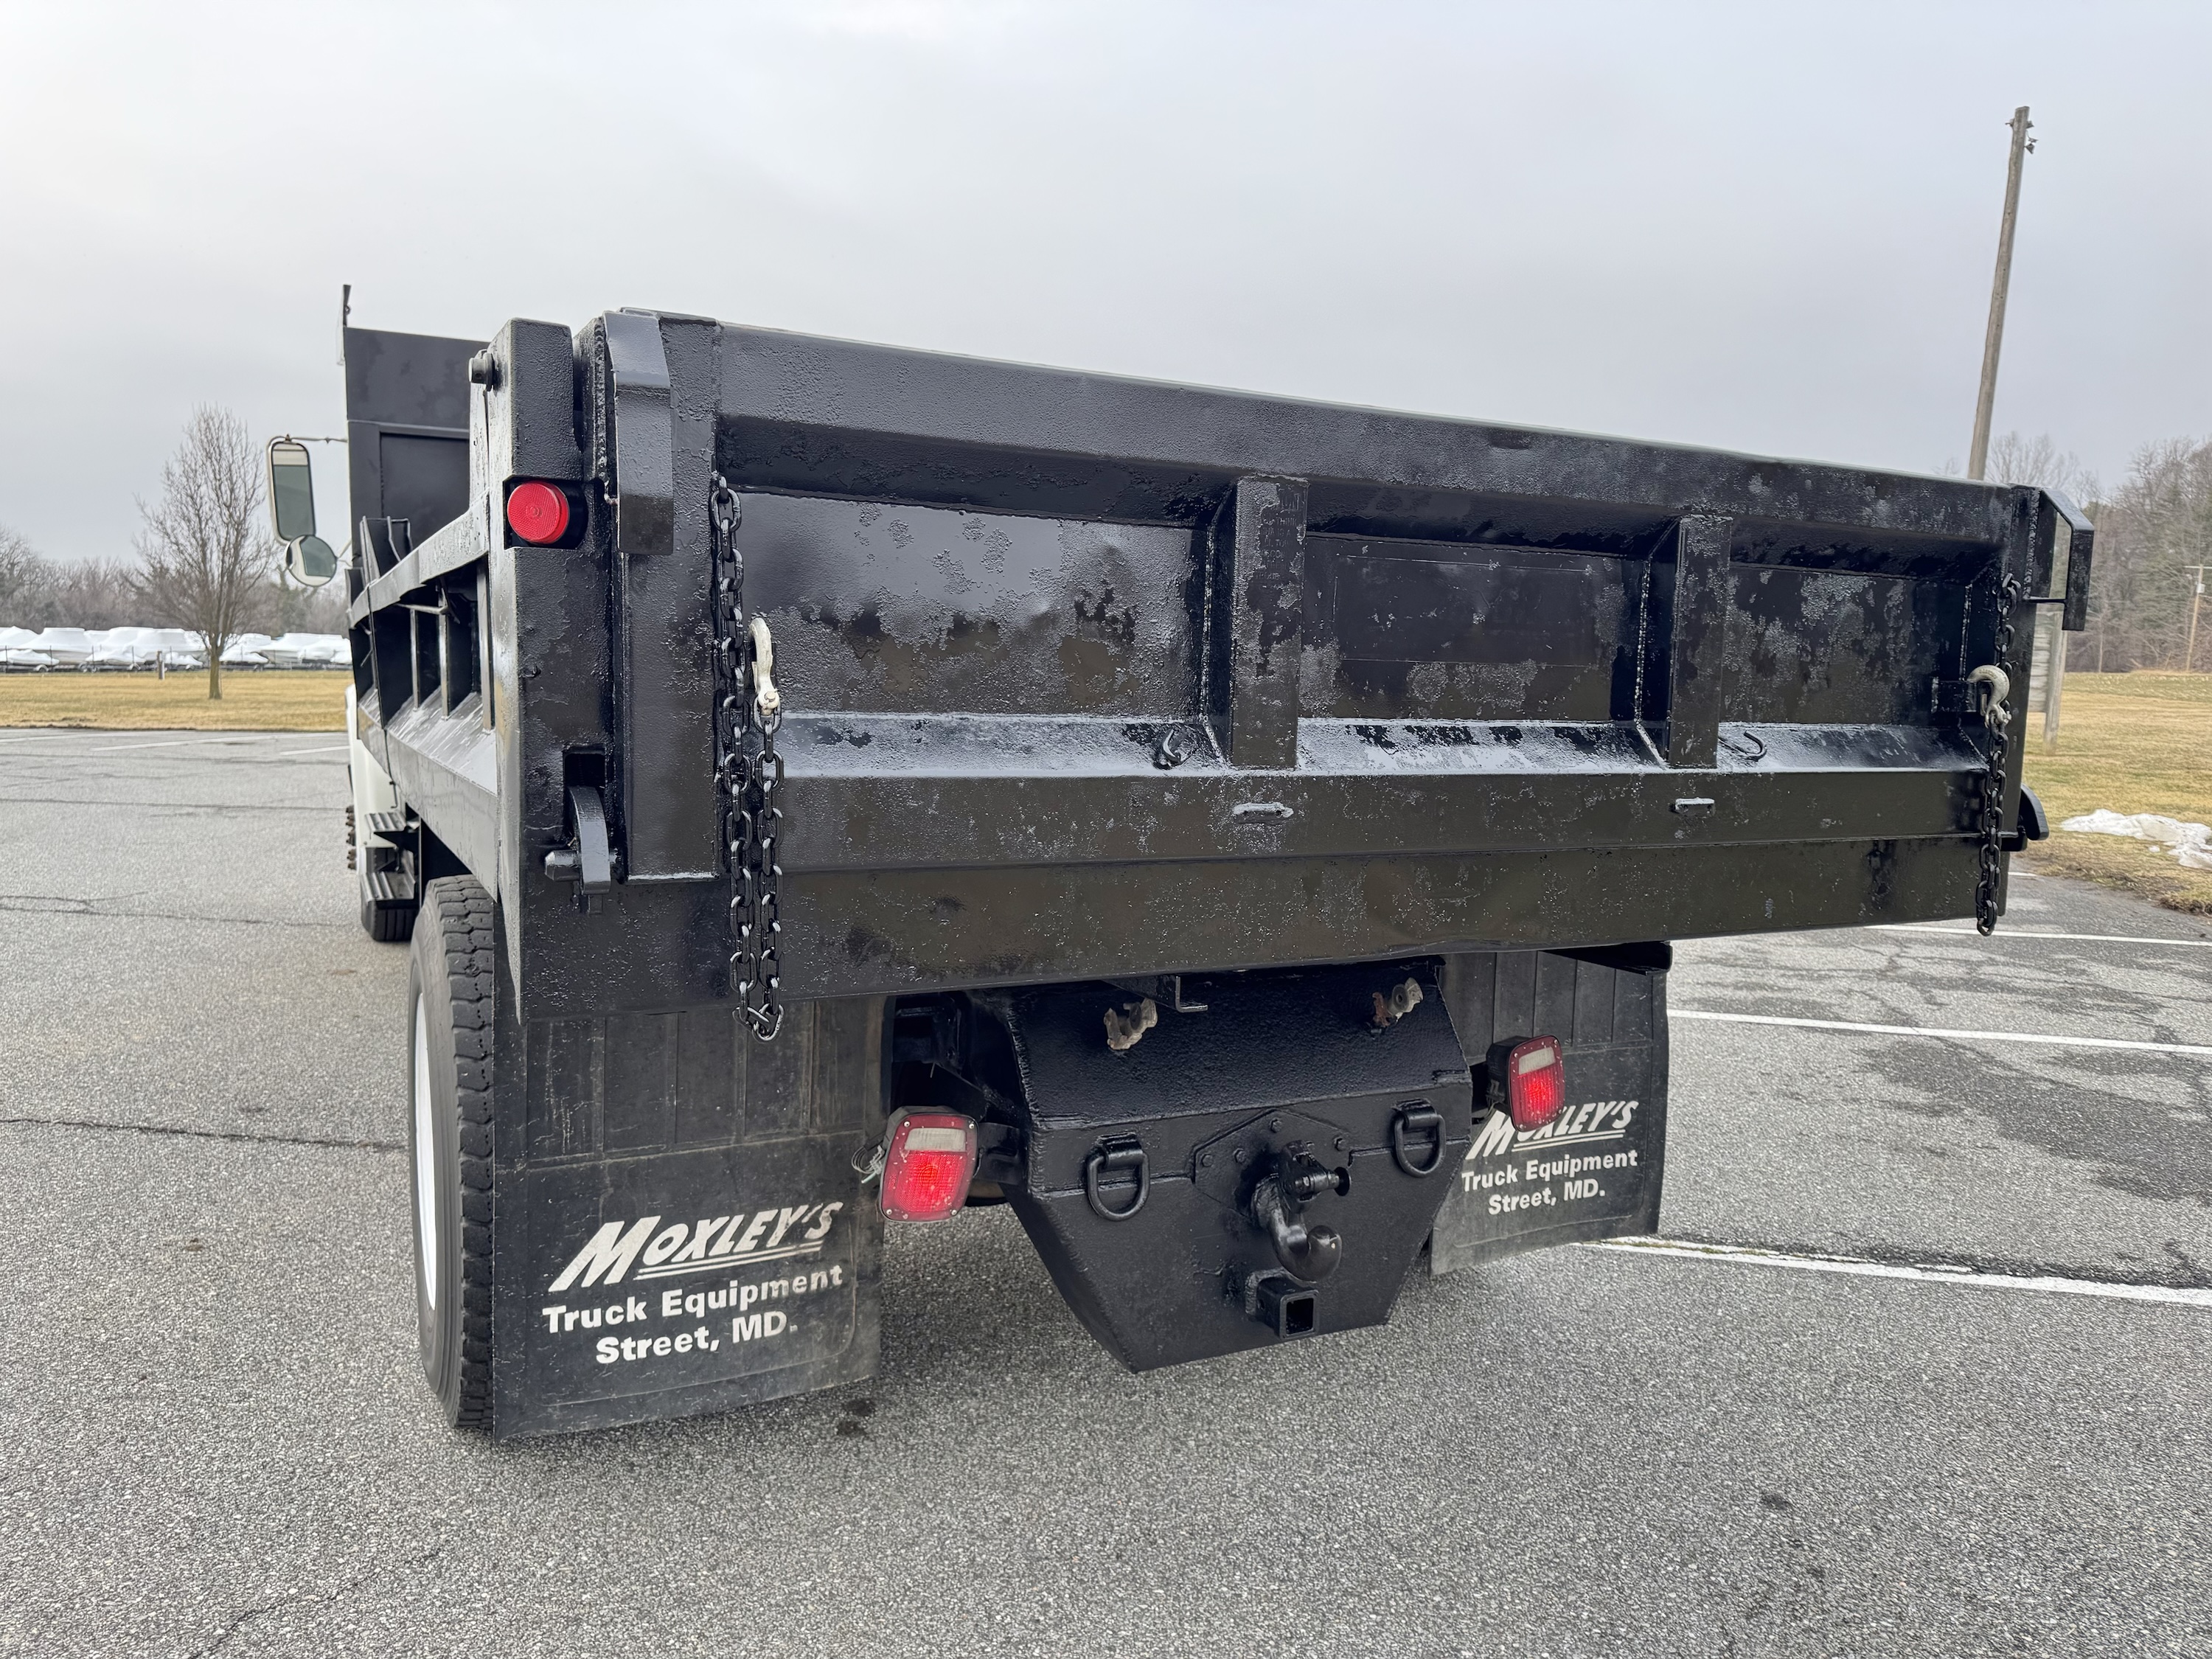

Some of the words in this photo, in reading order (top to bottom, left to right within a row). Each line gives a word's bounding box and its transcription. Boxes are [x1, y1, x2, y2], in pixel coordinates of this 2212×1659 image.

[1461, 1165, 1518, 1192] Truck
[1525, 1150, 1638, 1181] Equipment
[1488, 1186, 1557, 1215] Street,
[1563, 1178, 1606, 1201] MD.
[548, 1202, 844, 1293] MOXLEY'S
[542, 1296, 647, 1333] Truck
[661, 1265, 844, 1319] Equipment
[595, 1326, 720, 1364] Street,
[731, 1310, 799, 1345] MD.
